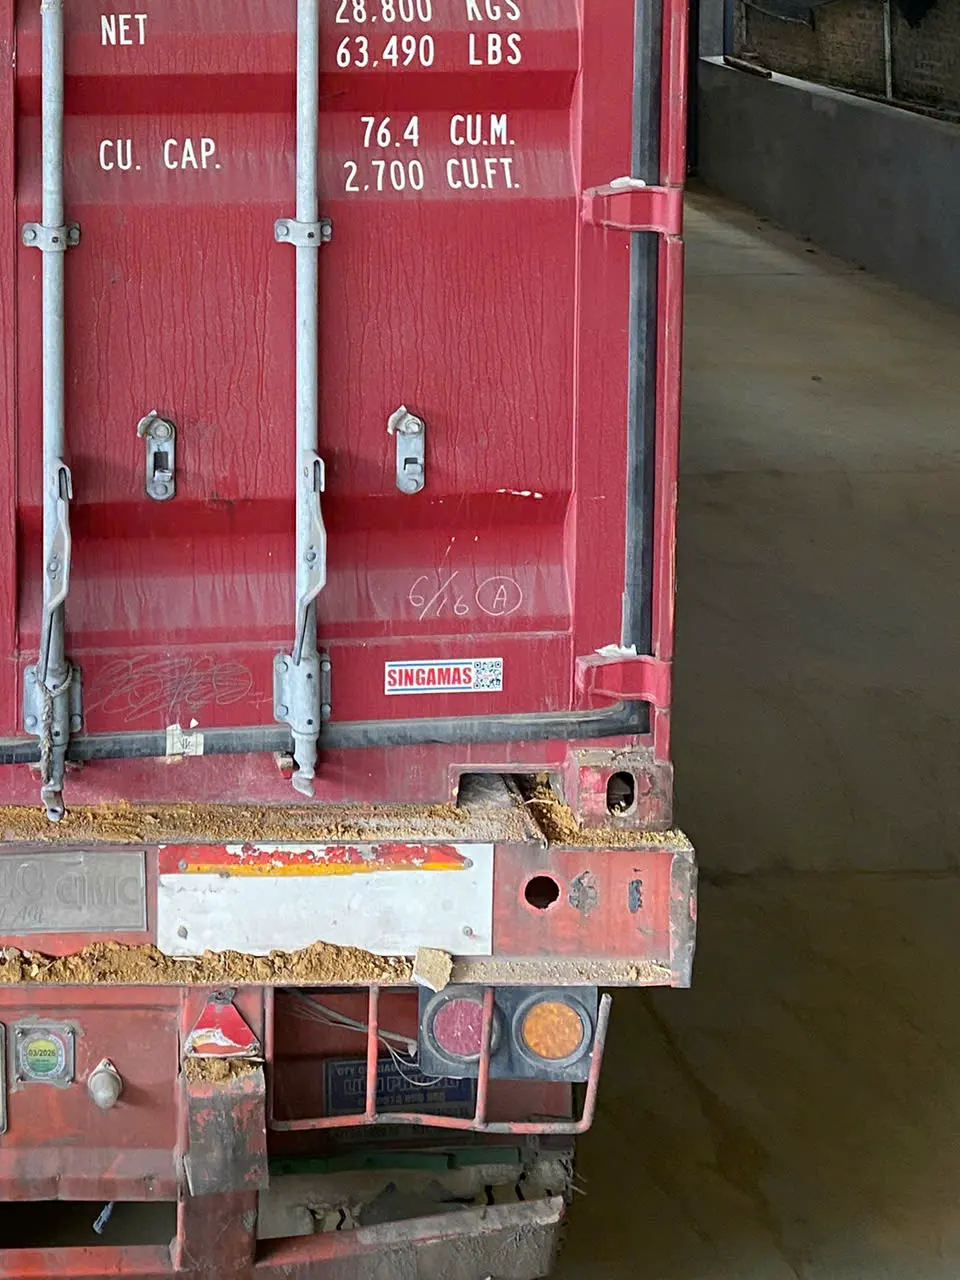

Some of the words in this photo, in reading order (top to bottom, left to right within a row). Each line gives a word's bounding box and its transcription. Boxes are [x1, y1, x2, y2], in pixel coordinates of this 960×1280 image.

[101, 14, 147, 45] NET
[469, 34, 522, 66] LBS
[99, 140, 141, 170] CU.
[164, 138, 221, 169] CAP.
[361, 116, 420, 148] 76.4
[450, 114, 515, 145] CU.M.
[447, 158, 520, 189] CU.FT.
[387, 667, 472, 688] SINGAMAS
[28, 1049, 56, 1057] 03/2026
